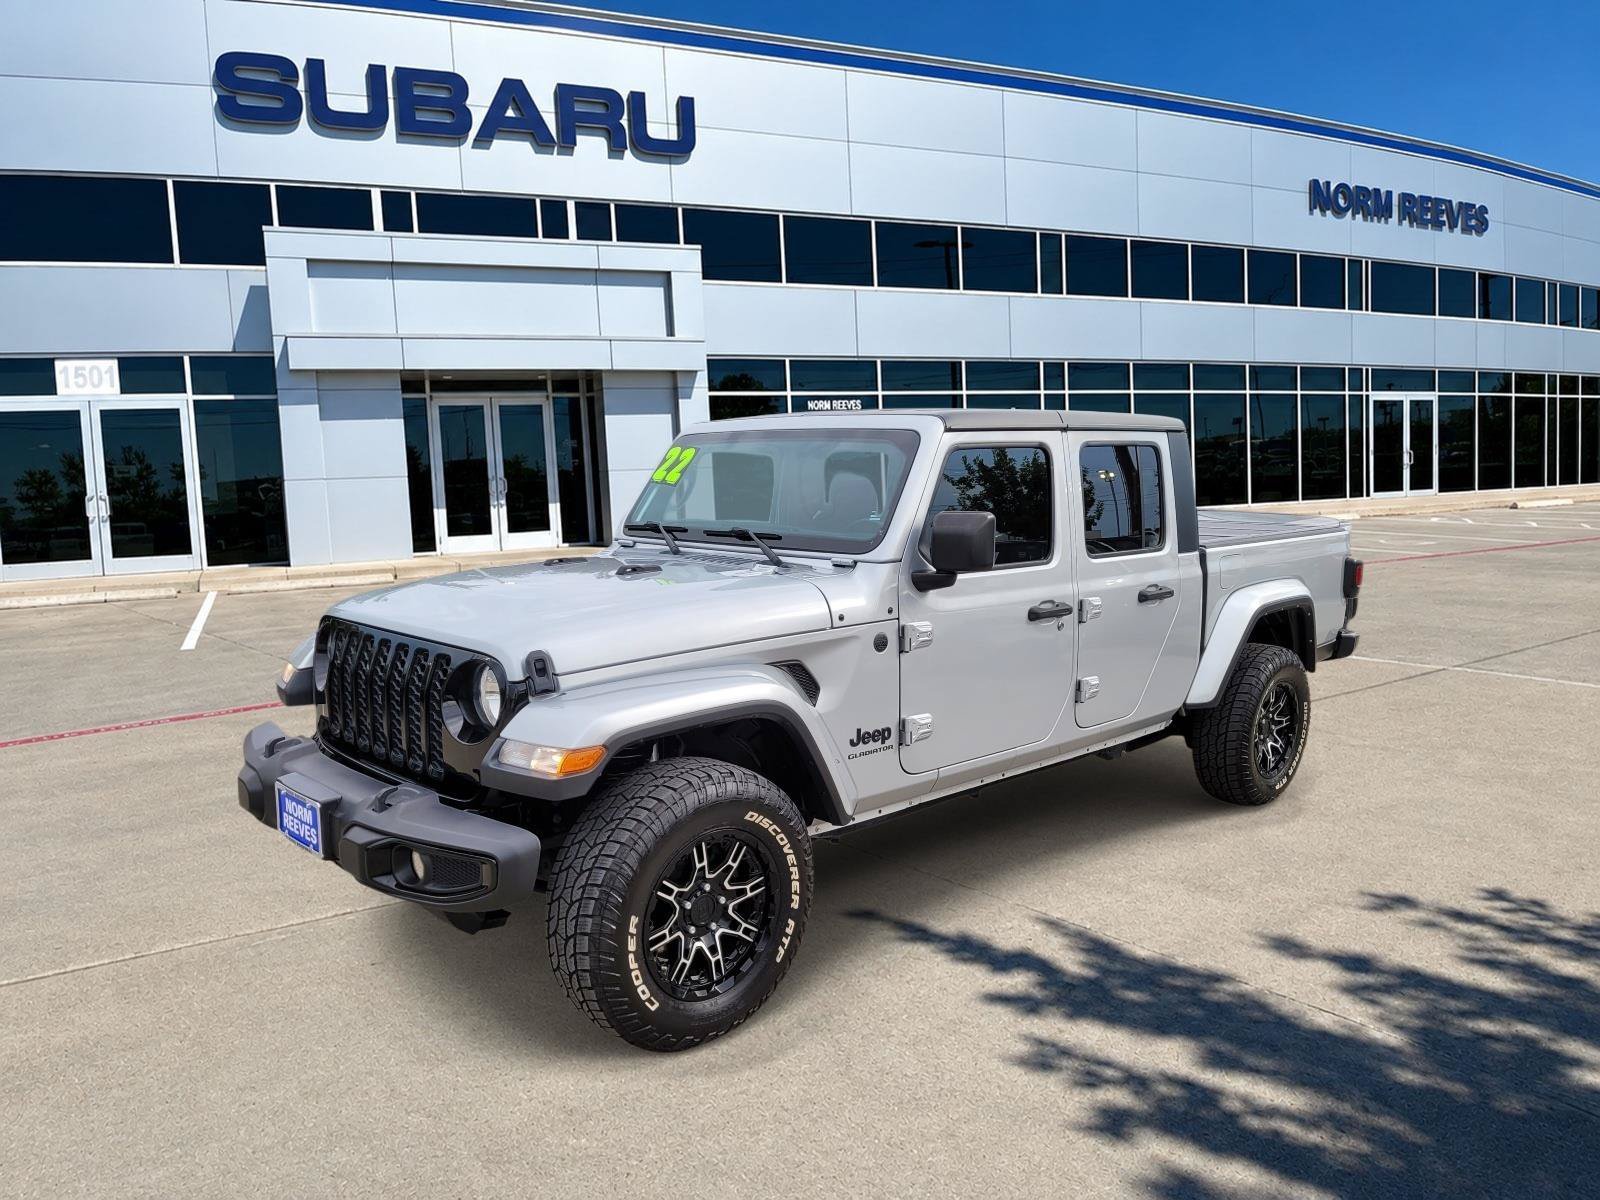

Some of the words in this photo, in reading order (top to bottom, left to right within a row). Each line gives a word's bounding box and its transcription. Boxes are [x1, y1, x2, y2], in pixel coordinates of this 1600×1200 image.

[214, 51, 695, 155] SUBARU
[1309, 178, 1393, 221] NORM
[1398, 191, 1490, 235] REEVES
[59, 365, 115, 389] 1501
[807, 400, 831, 410] NORM
[832, 400, 862, 410] REEVES
[652, 446, 696, 485] 22
[847, 744, 894, 760] GLADIATOR
[849, 726, 892, 747] Jeep
[1288, 701, 1308, 776] DISCOVERER
[283, 812, 317, 844] REEVES
[285, 797, 313, 826] NORM
[743, 810, 800, 910] DISCOVERER
[775, 918, 795, 963] ATP
[628, 914, 660, 1012] COOPER
